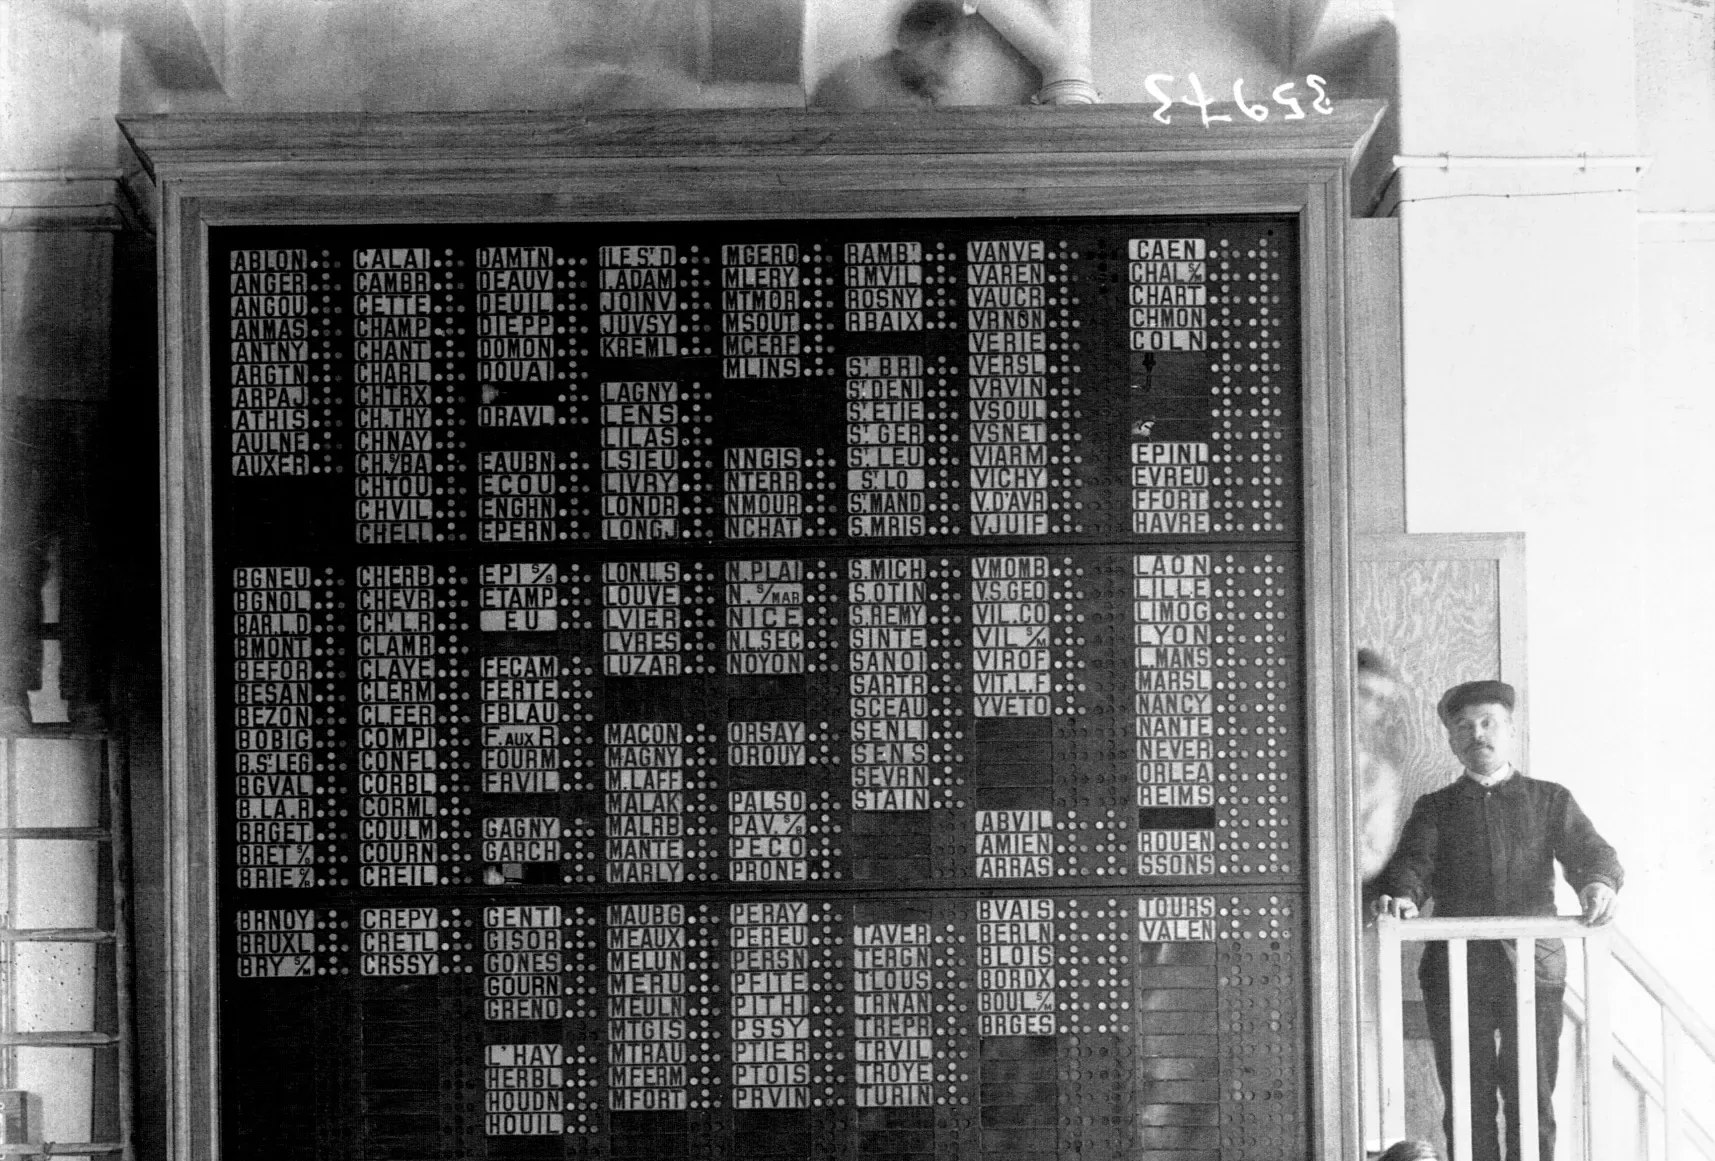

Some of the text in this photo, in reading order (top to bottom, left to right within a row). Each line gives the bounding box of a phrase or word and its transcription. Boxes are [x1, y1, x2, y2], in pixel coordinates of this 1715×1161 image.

[480, 247, 550, 266] DAMTN
[971, 241, 1041, 260] VANVE
[1137, 239, 1196, 258] CAEN
[235, 249, 304, 270] ABLON
[357, 272, 427, 291] CAMBR
[481, 270, 550, 289] DEAUV
[726, 267, 795, 286] MLERY
[849, 266, 917, 285] RMVIL
[971, 264, 1041, 283] VAREN
[604, 292, 674, 311] JOINV
[972, 287, 1042, 306] VAUCR
[1133, 285, 1200, 304] CHART
[481, 316, 551, 335] DIEPP
[604, 315, 672, 334] JUVSY
[727, 313, 796, 332] MSOUT
[849, 312, 918, 331] RBAIX
[1133, 308, 1203, 327] CHMON
[236, 319, 305, 338] ANMAS
[358, 318, 428, 337] CHAMP
[358, 340, 428, 359] CHANT
[481, 338, 551, 357] DOMON
[972, 332, 1041, 351] VERIE
[236, 342, 304, 361] ANTNY
[358, 363, 427, 382] CHARL
[727, 358, 797, 377] MLINS
[973, 355, 1042, 374] VERSL
[605, 383, 673, 402] LAGNY
[605, 405, 675, 424] LENS
[973, 400, 1042, 419] VSOUL
[236, 410, 306, 429] ATHIS
[359, 431, 428, 450] CHNAY
[606, 427, 675, 446] LILAS
[974, 423, 1040, 442] VSNET
[729, 449, 798, 468] NNGIS
[974, 446, 1044, 465] VIARM
[974, 469, 1044, 488] VICHY
[1136, 467, 1205, 486] EVREU
[360, 477, 429, 496] CHTOU
[483, 498, 553, 517] ENGHN
[729, 494, 798, 513] NMOUR
[1136, 489, 1202, 508] FFORT
[360, 500, 429, 519] CHVIL
[729, 519, 794, 538] NCHAT
[1136, 513, 1204, 532] HAVRE
[975, 557, 1045, 576] VMOMB
[1137, 555, 1207, 574] LAON
[238, 567, 308, 588] BGNEU
[484, 587, 554, 606] ETAMP
[607, 585, 676, 606] LOUVE
[1137, 579, 1204, 598] LILLE
[238, 591, 307, 610] BGNOL
[361, 589, 431, 608] CHEVR
[607, 609, 677, 628] LVIER
[731, 607, 797, 626] NICE
[1138, 601, 1207, 620] LIMOG
[504, 611, 539, 630] EU
[608, 633, 678, 652] LVRES
[854, 629, 921, 648] SINTE
[1138, 625, 1208, 644] LYON
[361, 635, 431, 656] CLAMR
[362, 659, 430, 678] CLAYE
[485, 657, 555, 676] FECAM
[608, 655, 678, 676] LUZAR
[731, 653, 800, 674] NOYON
[854, 675, 924, 694] SARTR
[1139, 671, 1208, 690] MARSL
[855, 698, 924, 717] SCEAU
[977, 696, 1047, 716] YVETO
[1139, 695, 1206, 714] NANCY
[239, 707, 309, 726] BEZON
[609, 723, 678, 744] MACON
[1139, 717, 1205, 736] NANTE
[239, 729, 309, 748] BOBIG
[486, 749, 556, 768] FOURM
[609, 747, 678, 766] MAGNY
[732, 745, 801, 766] OROUY
[855, 744, 925, 763] SENS
[1140, 740, 1210, 759] NEVER
[363, 751, 432, 770] CONFL
[856, 767, 925, 786] SEVRN
[1140, 763, 1209, 782] ORLEA
[239, 775, 309, 794] BGVAL
[363, 774, 432, 794] CORBL
[856, 789, 926, 810] STAIN
[1140, 785, 1210, 806] REIMS
[363, 797, 432, 816] CORML
[363, 820, 433, 840] COULM
[487, 817, 556, 838] GAGNY
[982, 811, 1048, 830] ABVIL
[487, 841, 557, 860] GARCH
[610, 839, 678, 858] MANTE
[981, 834, 1049, 854] AMIEN
[1141, 831, 1211, 852] ROUEN
[364, 843, 434, 862] COURN
[734, 861, 801, 880] PRONE
[980, 857, 1050, 878] ARRAS
[1141, 855, 1211, 876] SSONS
[364, 866, 433, 886] CREIL
[611, 905, 681, 924] MAUBG
[734, 903, 802, 922] PERAY
[980, 899, 1050, 920] BVAIS
[1143, 897, 1212, 916] TOURS
[240, 909, 311, 930] BRNOY
[364, 909, 433, 928] CREPY
[611, 929, 680, 948] MEAUX
[735, 927, 804, 946] PEREU
[980, 923, 1050, 942] BERLN
[1143, 921, 1212, 942] VALEN
[241, 934, 311, 953] BRUXL
[365, 933, 434, 952] CRETL
[365, 955, 435, 976] CRSSY
[488, 953, 558, 972] GONES
[611, 951, 682, 970] MELUN
[859, 949, 928, 968] TERGN
[981, 947, 1051, 966] BLOIS
[488, 977, 558, 996] GOURN
[612, 975, 682, 994] MERU
[981, 969, 1050, 988] BORDX
[612, 1021, 682, 1040] MTGIS
[736, 1019, 803, 1038] PSSY
[982, 1015, 1052, 1036] BRGES
[861, 1041, 928, 1060] TRVIL
[736, 1065, 806, 1084] PTOIS
[860, 1063, 928, 1082] TROYE
[490, 1115, 559, 1134] HOUIL
